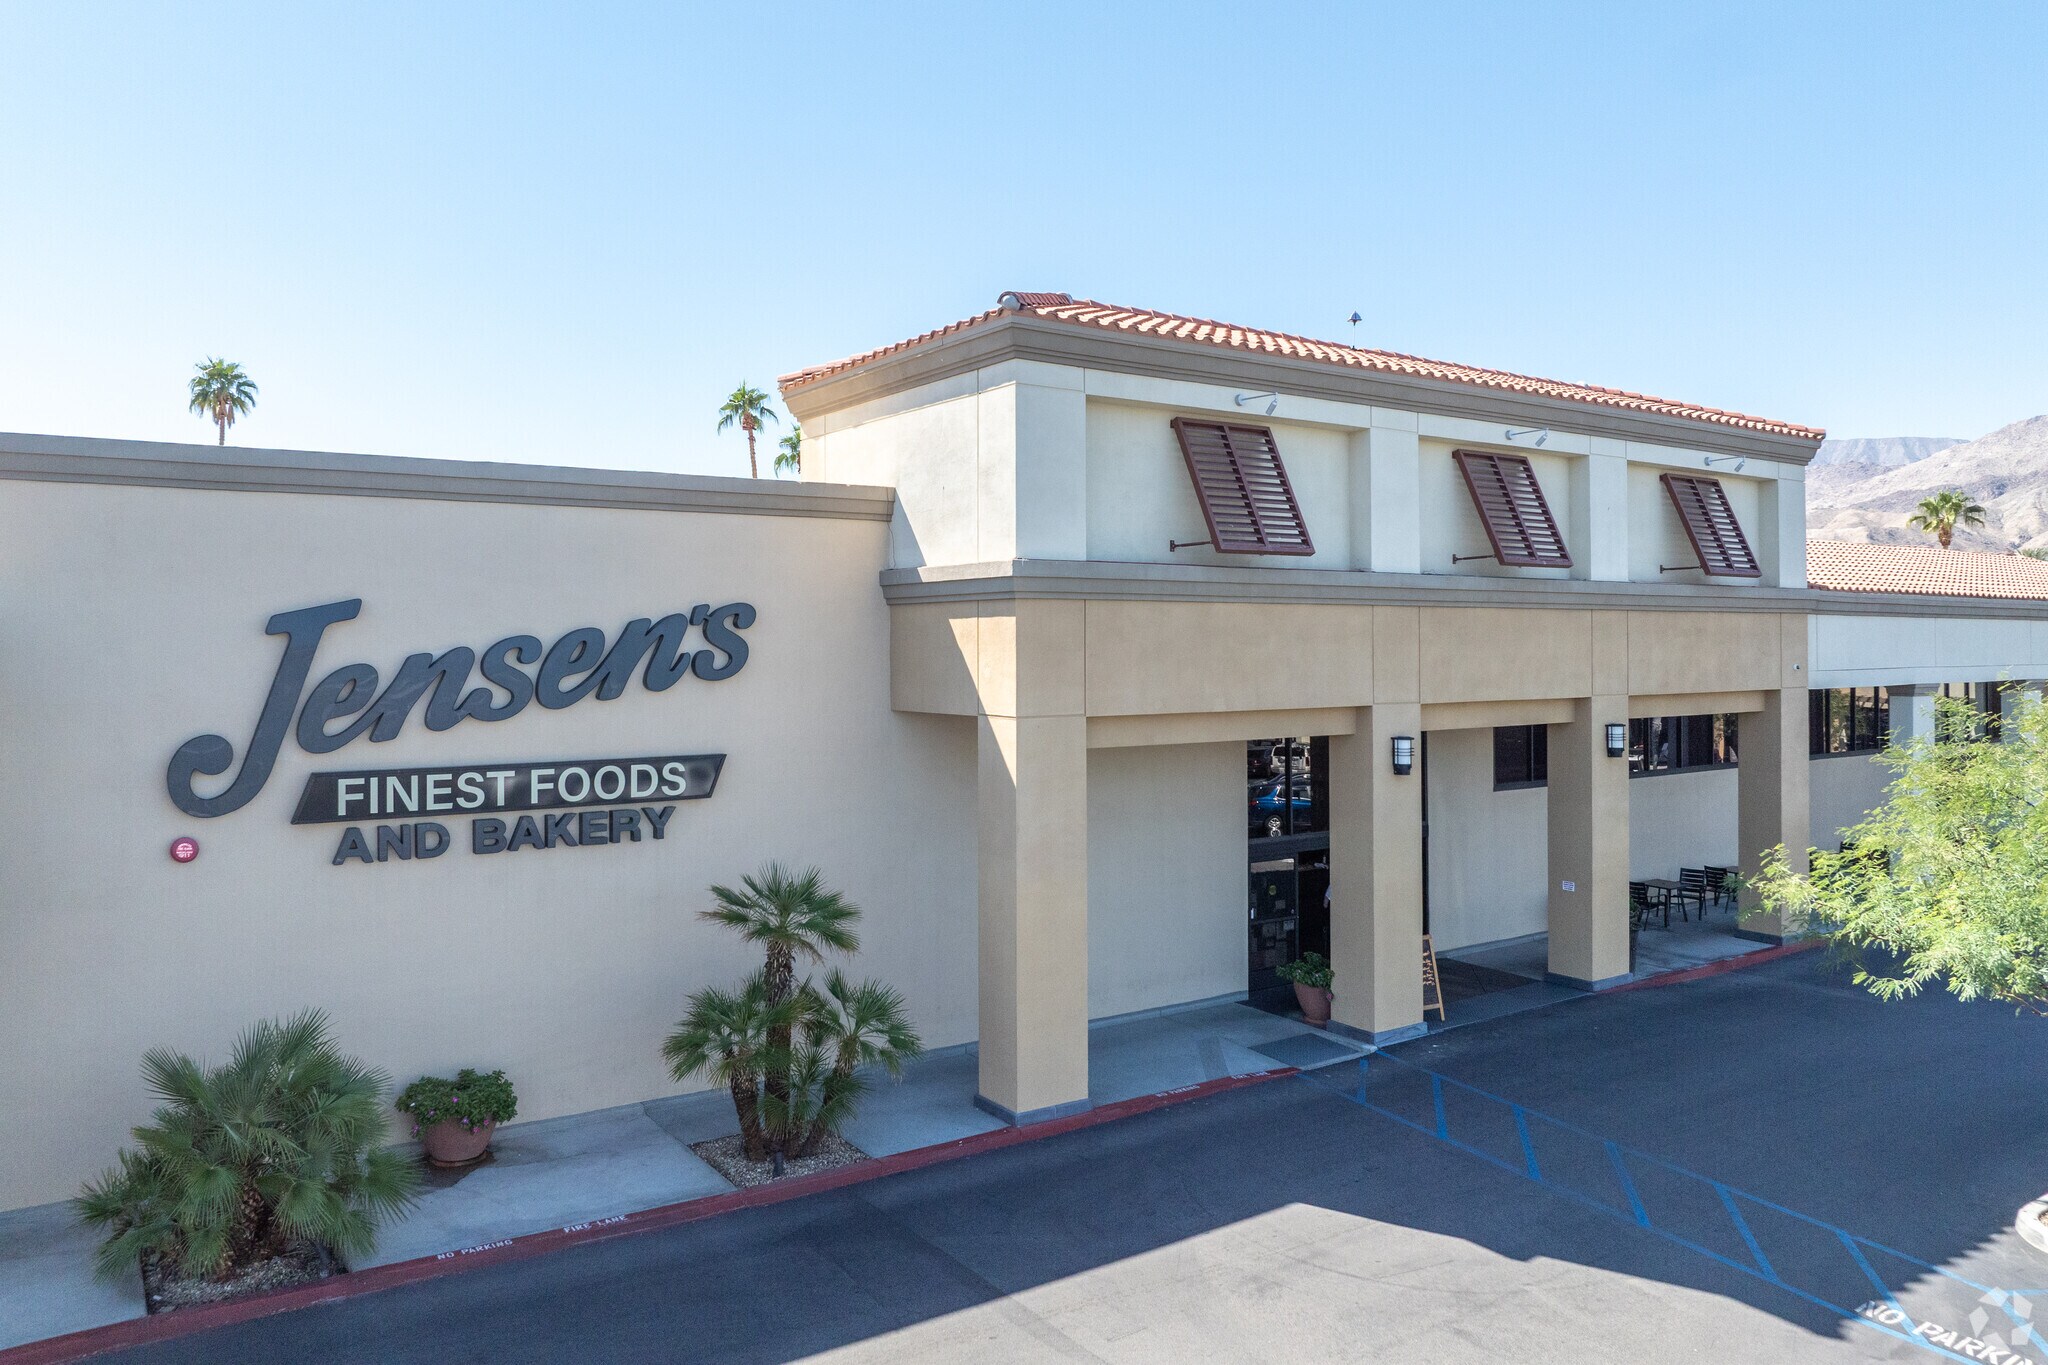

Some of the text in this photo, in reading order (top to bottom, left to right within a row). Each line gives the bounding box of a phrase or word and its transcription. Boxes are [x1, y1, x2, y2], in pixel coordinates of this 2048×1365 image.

[167, 598, 757, 818] Jensen's
[337, 761, 687, 817] FINEST FOODS
[332, 806, 676, 866] AND BAKERY
[1168, 1085, 1200, 1094] PARKING
[563, 1214, 628, 1234] FIRE LANE
[437, 1238, 513, 1260] NO PARKING
[1854, 1300, 1905, 1325] NO
